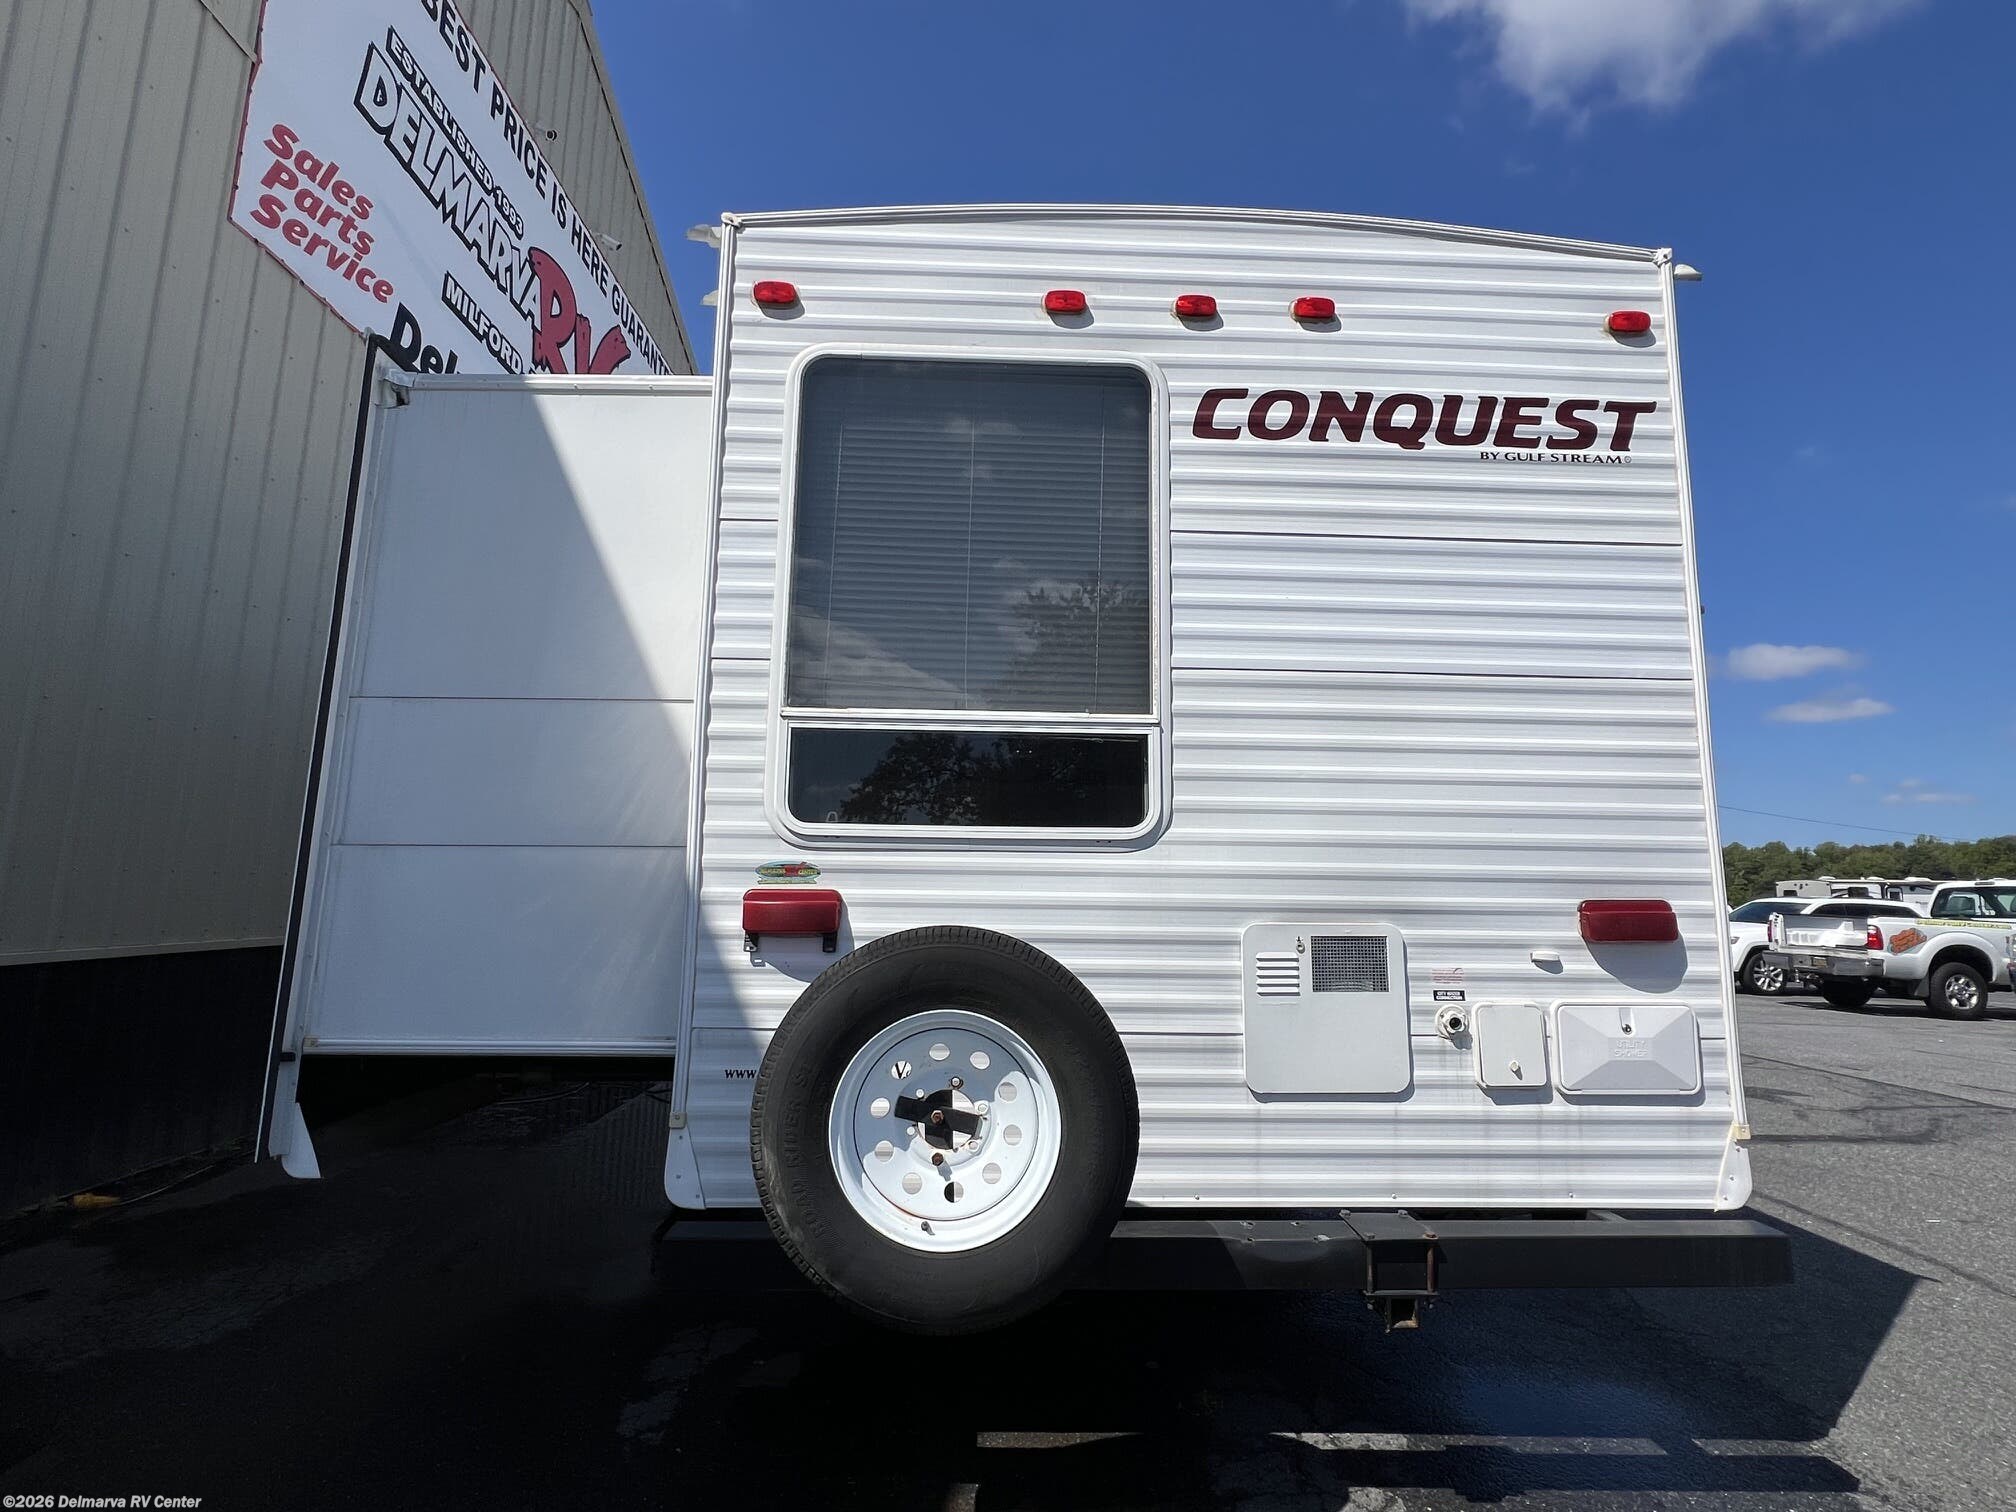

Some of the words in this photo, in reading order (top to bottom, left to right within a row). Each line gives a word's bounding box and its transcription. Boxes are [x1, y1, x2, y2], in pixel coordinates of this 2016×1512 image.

[263, 124, 374, 220] Sales
[387, 27, 495, 195] ESTABLISHED
[495, 186, 524, 239] 1993
[260, 159, 375, 255] Parts
[353, 41, 543, 334] DELMARVA
[528, 246, 632, 375] RV
[490, 81, 548, 200] PRICE
[551, 181, 567, 230] IS
[571, 213, 610, 298] HERE
[250, 194, 394, 303] Service
[1192, 388, 1657, 452] CONQUEST
[1480, 452, 1500, 461] BY
[1505, 452, 1546, 462] GULF
